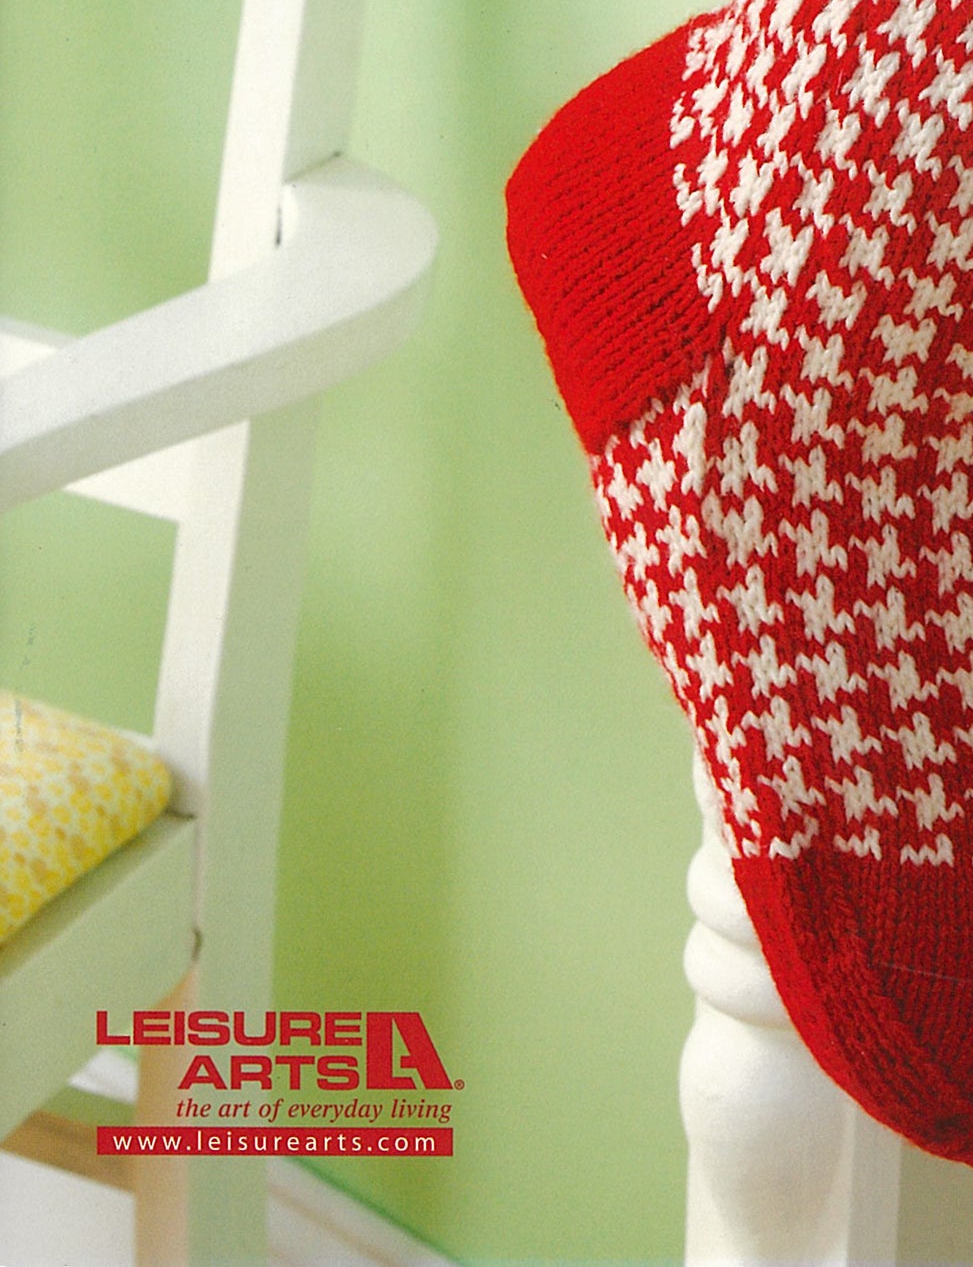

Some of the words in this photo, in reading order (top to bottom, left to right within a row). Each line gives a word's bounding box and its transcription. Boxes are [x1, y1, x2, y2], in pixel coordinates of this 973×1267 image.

[96, 1011, 362, 1046] LEISURE
[178, 1055, 359, 1090] ARTS
[176, 1098, 210, 1118] the
[218, 1100, 250, 1118] art
[259, 1098, 284, 1123] of
[288, 1098, 383, 1123] everyday
[391, 1098, 452, 1123] living
[113, 1130, 436, 1152] www.leisurearts.com
